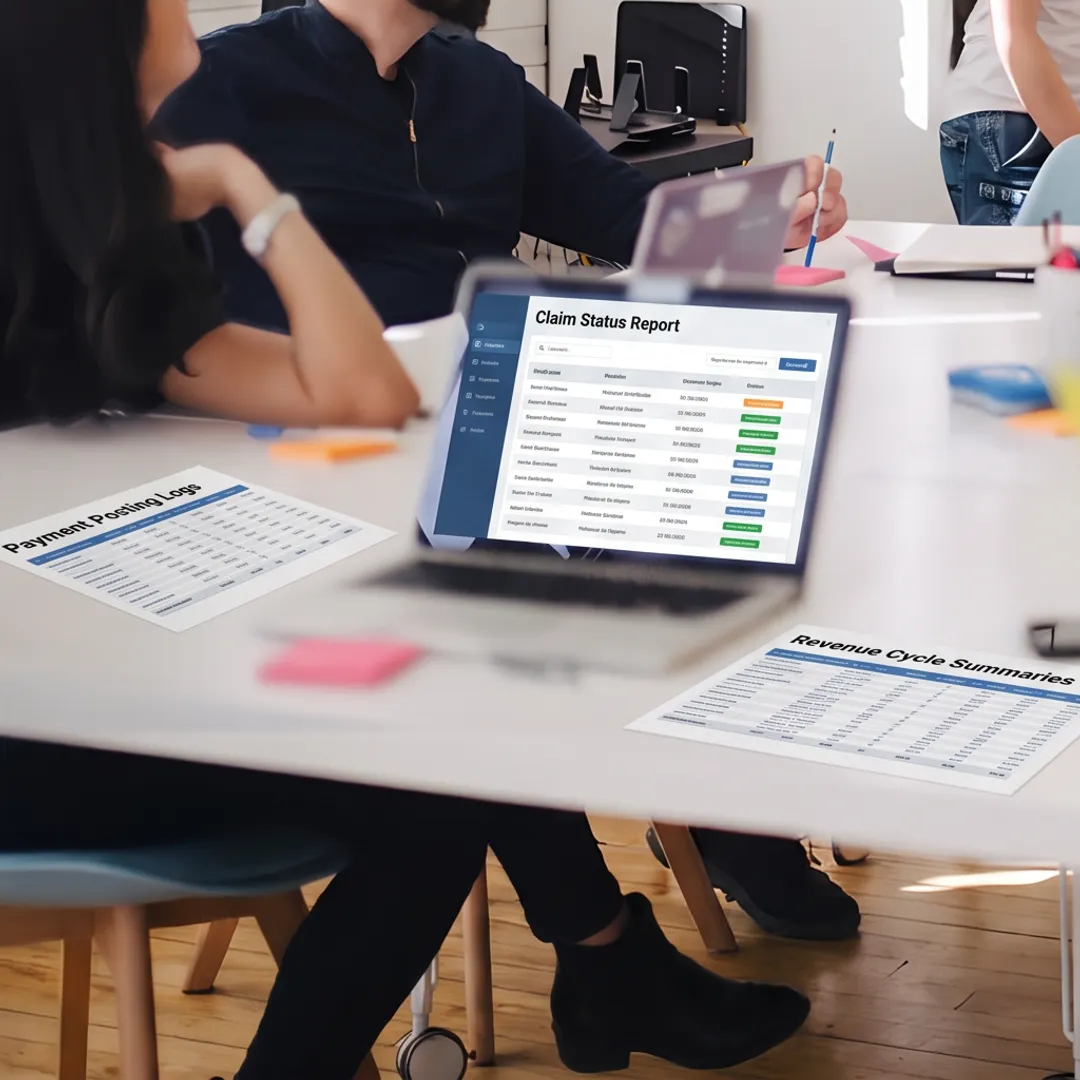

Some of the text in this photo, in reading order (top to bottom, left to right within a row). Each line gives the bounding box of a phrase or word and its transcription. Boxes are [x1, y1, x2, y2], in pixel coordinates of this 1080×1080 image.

[535, 310, 681, 334] Claim Status Report
[1, 483, 202, 554] Payment Posting Logs
[789, 634, 1076, 687] Revenue Cycle Summaries
